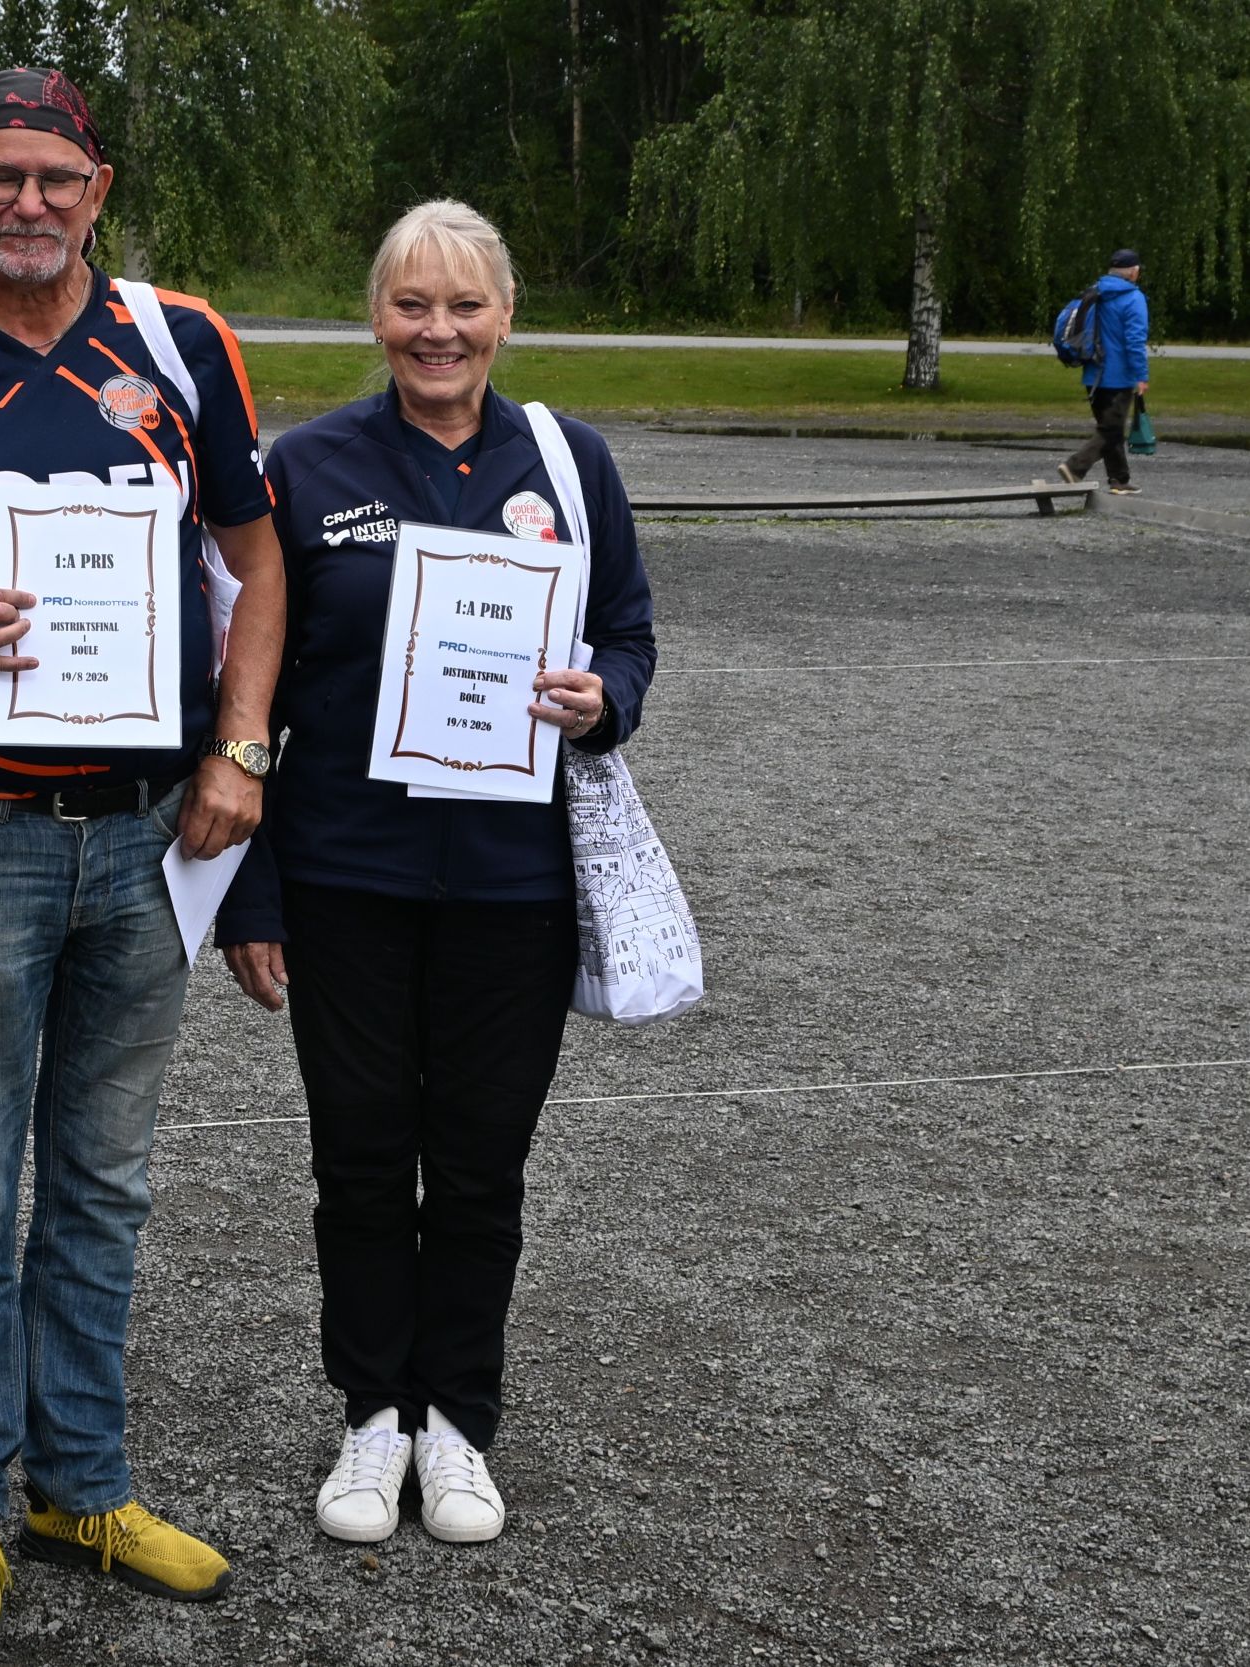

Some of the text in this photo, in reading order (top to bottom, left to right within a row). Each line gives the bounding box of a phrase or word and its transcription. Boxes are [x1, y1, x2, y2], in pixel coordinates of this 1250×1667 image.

[106, 389, 138, 401] BODENS
[141, 413, 159, 425] 1984
[322, 503, 373, 527] CRAFT
[510, 504, 540, 515] BODENS
[351, 518, 397, 537] INTER
[514, 514, 554, 529] PETANQUE
[54, 553, 115, 570] 1:A PRIS
[42, 596, 73, 606] PRO
[454, 599, 513, 622] 1:A PRIS
[50, 621, 120, 632] DISTRIKTSFINAL
[71, 645, 99, 656] BOULE
[438, 640, 468, 653] PRO
[61, 671, 109, 683] 19/8 2026
[442, 666, 509, 684] DISTRIKTSFINAL
[459, 691, 487, 705] BOULE
[446, 716, 493, 732] 19/8 2026
